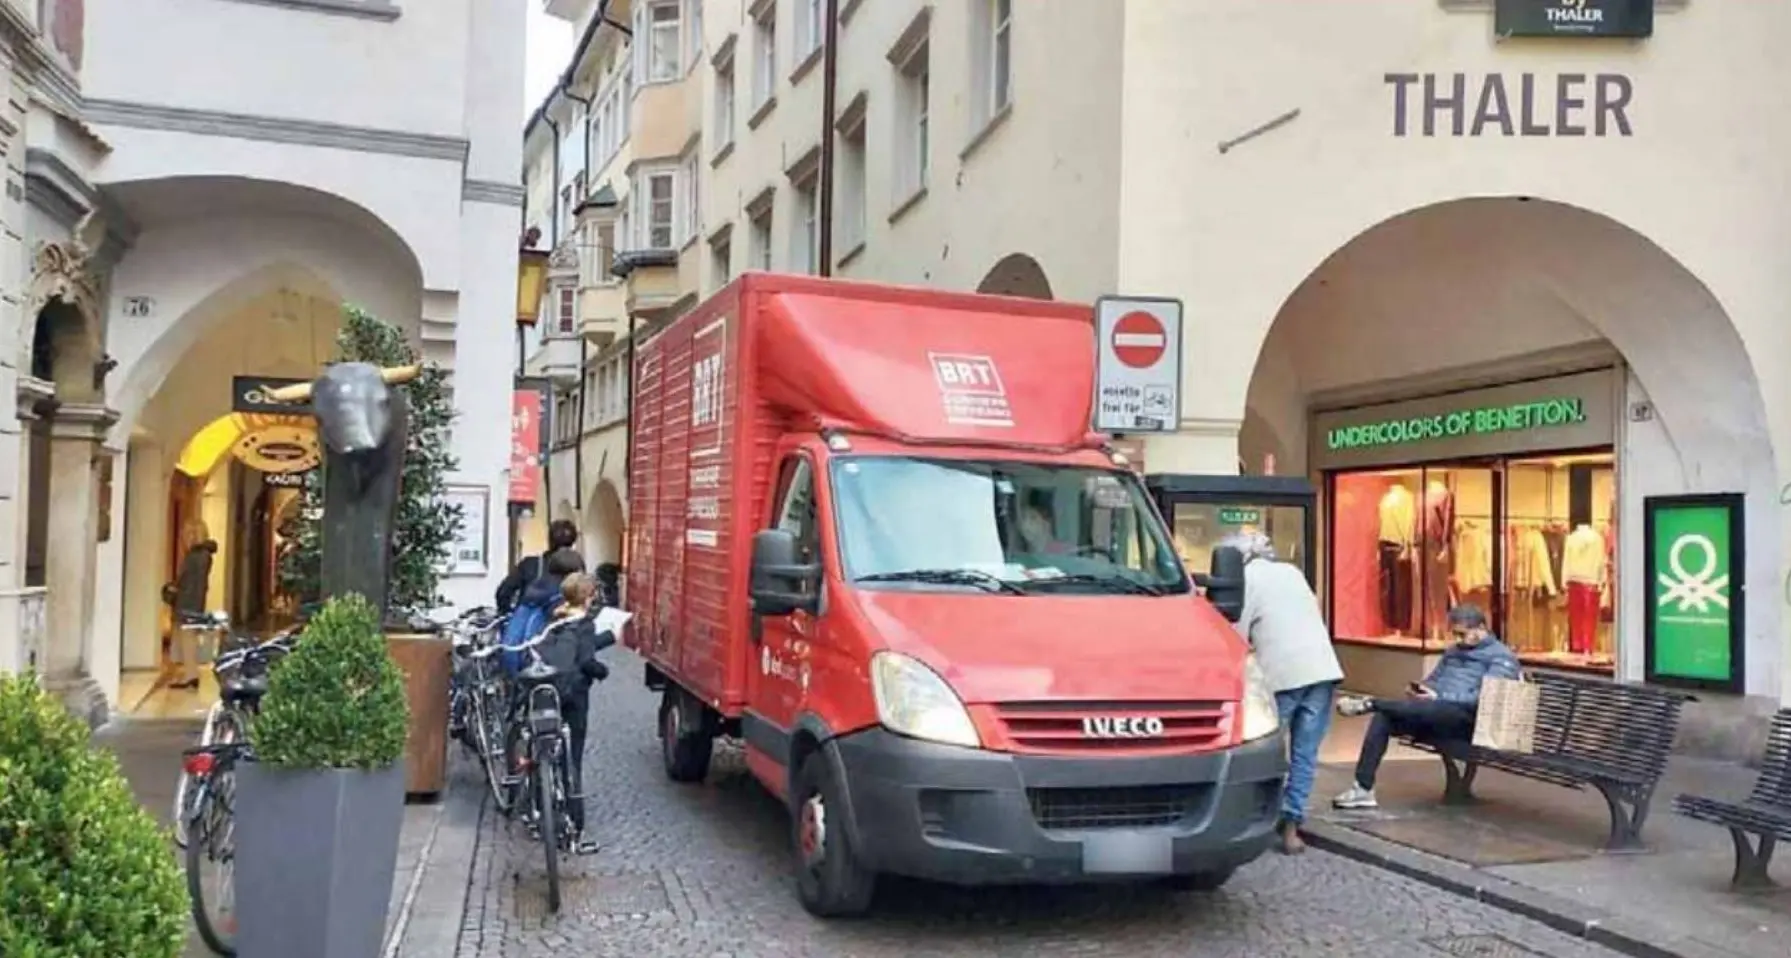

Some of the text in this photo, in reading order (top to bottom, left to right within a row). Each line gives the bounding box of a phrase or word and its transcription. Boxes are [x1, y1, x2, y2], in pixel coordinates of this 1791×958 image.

[1544, 8, 1604, 21] THALER
[1384, 73, 1633, 136] THALER
[938, 361, 990, 385] BRT
[1328, 415, 1442, 449] UNDERCOLORS
[1445, 410, 1473, 435] OF
[1083, 716, 1164, 737] IVECO
